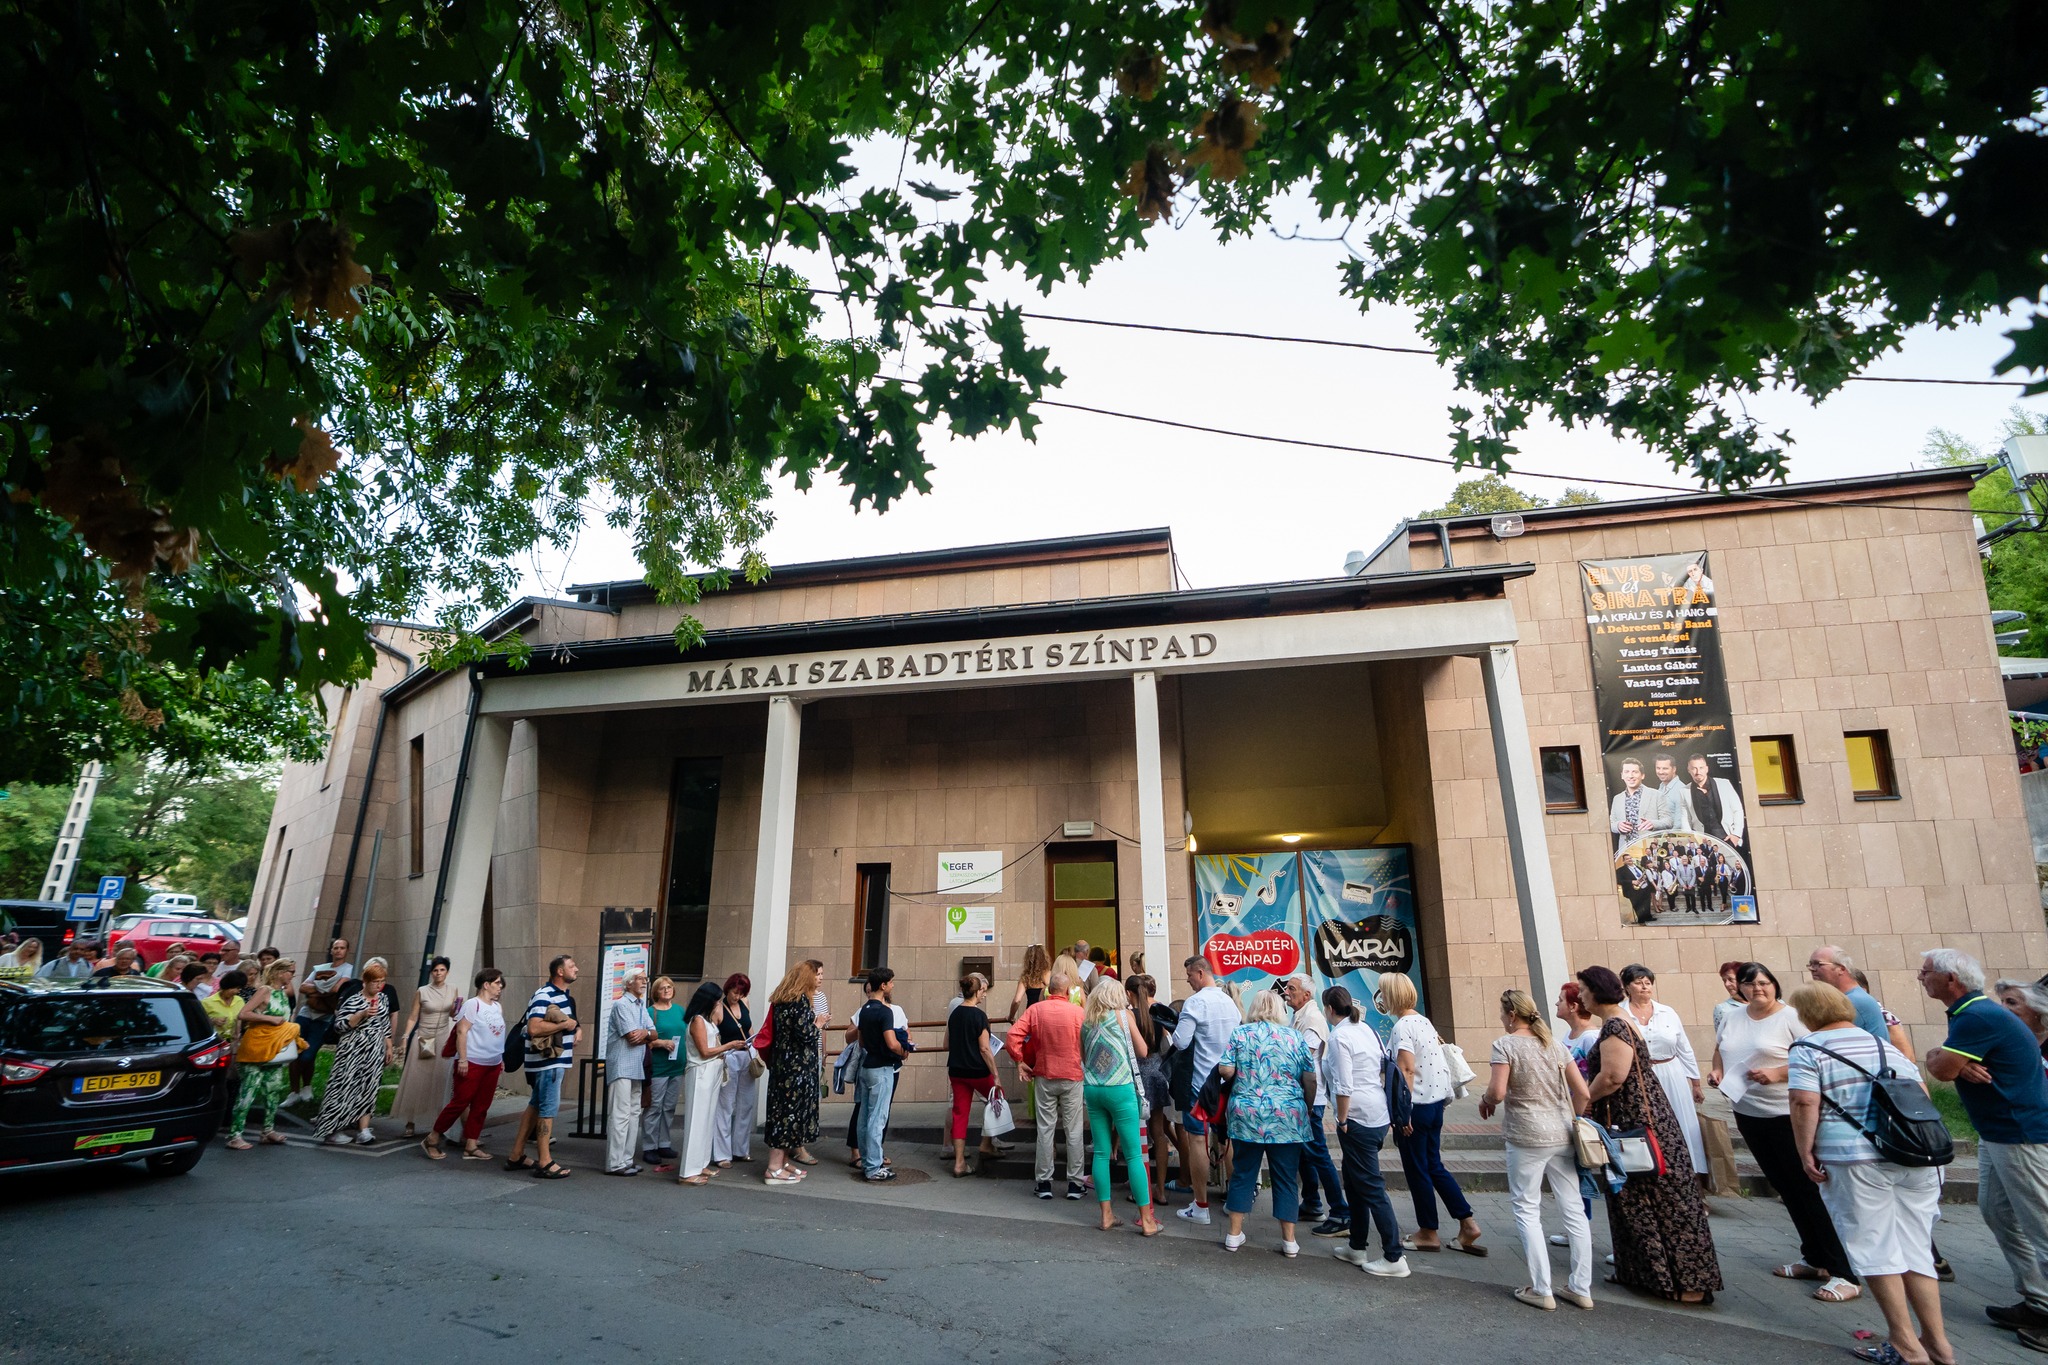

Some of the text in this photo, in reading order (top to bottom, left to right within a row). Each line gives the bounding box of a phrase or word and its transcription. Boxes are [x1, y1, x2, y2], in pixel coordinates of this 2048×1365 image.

[1588, 565, 1655, 585] ELVIS
[1621, 576, 1639, 594] és
[1591, 586, 1710, 611] SINATRA
[1601, 607, 1705, 623] A KIRÁLY ÉS A HANG
[1596, 619, 1713, 634] A Debrecen Big Band
[1623, 632, 1690, 644] és vendégei
[1619, 645, 1697, 658] Vastag Tamás
[688, 632, 1218, 693] MÁRAI SZABADTÉRI SZÍNPAD
[1623, 661, 1698, 673] Lantos Gábor
[1625, 676, 1700, 689] Vastag Csaba
[1648, 700, 1693, 708] augusztus
[1693, 697, 1706, 705] 11.
[1653, 708, 1678, 716] 20.00
[103, 879, 119, 896] P
[1209, 939, 1294, 952] SZABADTÉRI
[1323, 938, 1405, 960] MÁRAI
[1222, 953, 1282, 966] SZÍNPAD
[1331, 960, 1399, 968] SZÉPASSZONY-VÖLGY
[86, 1074, 157, 1091] EDF-978
